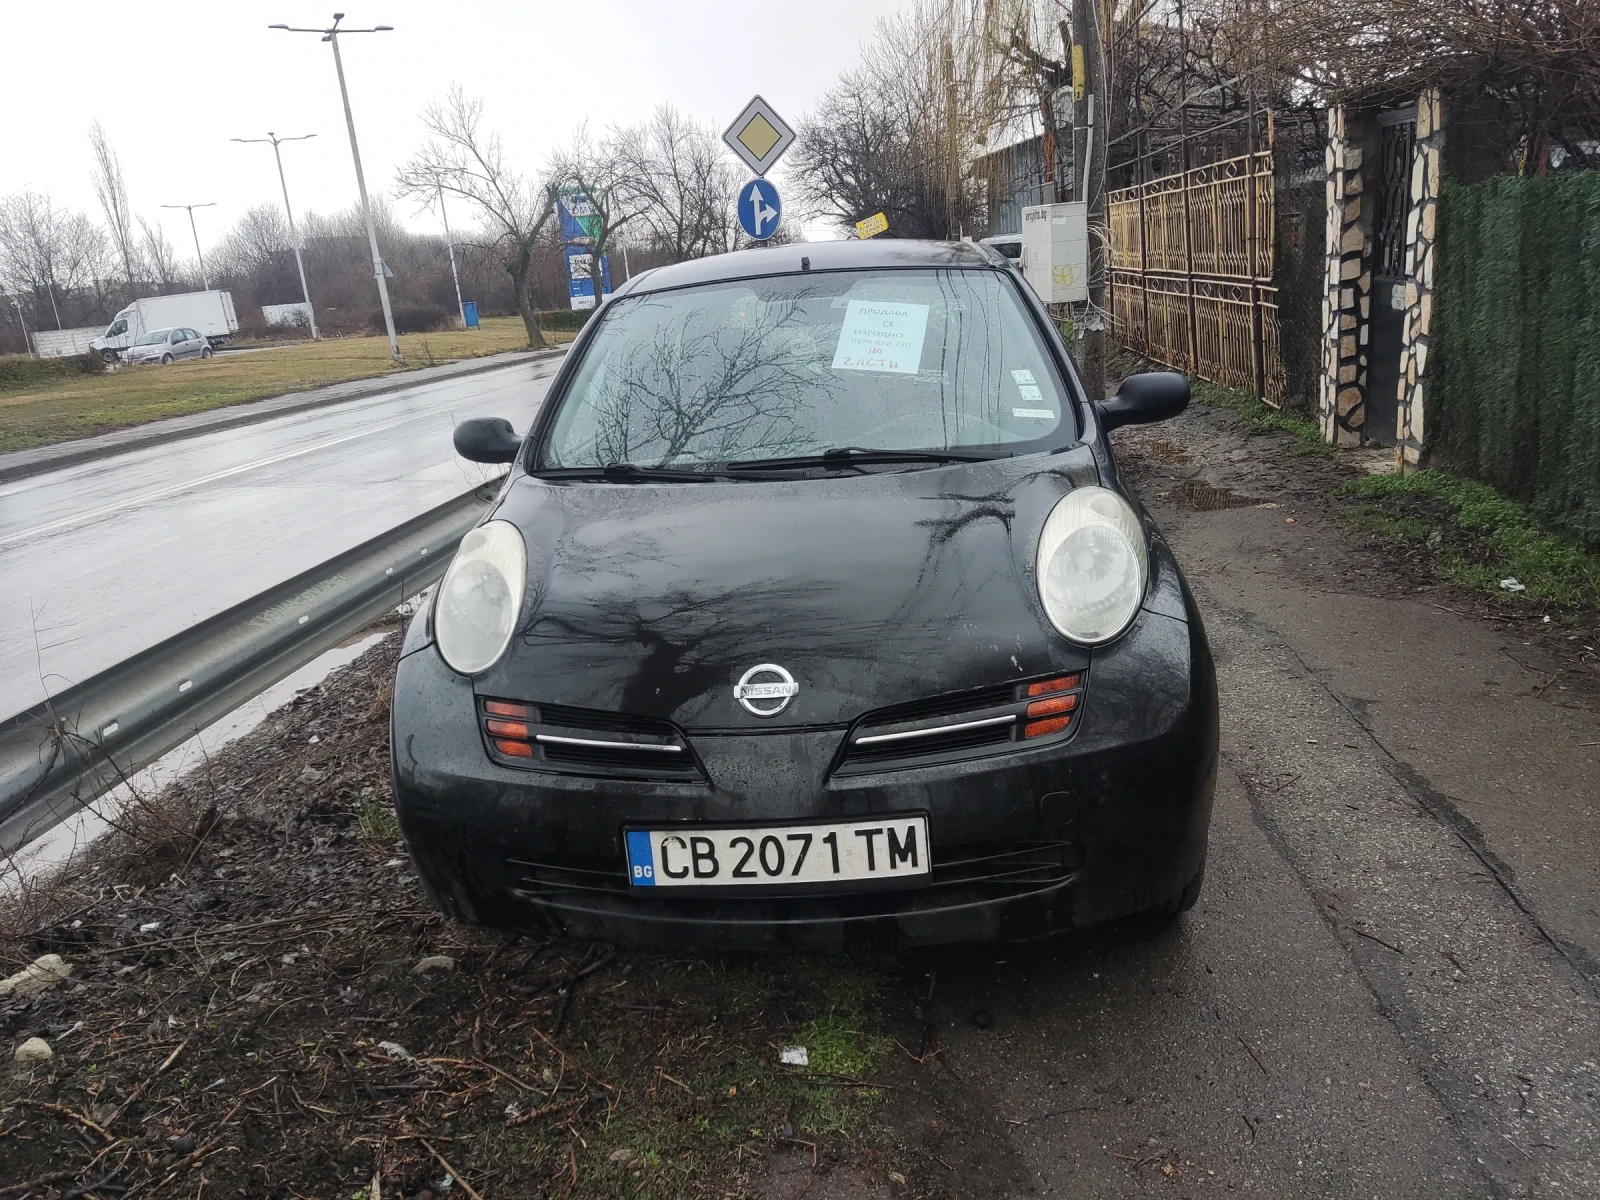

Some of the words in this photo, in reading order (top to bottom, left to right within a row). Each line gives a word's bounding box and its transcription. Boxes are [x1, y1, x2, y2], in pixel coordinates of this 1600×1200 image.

[859, 307, 908, 317] ПРОДАВА
[882, 320, 895, 328] СЕ
[853, 328, 904, 338] ИЗГОДНО
[740, 685, 791, 697] NISSAN
[661, 835, 720, 879] CB
[728, 831, 842, 878] 2071
[854, 826, 919, 871] TM
[634, 865, 653, 879] BG
